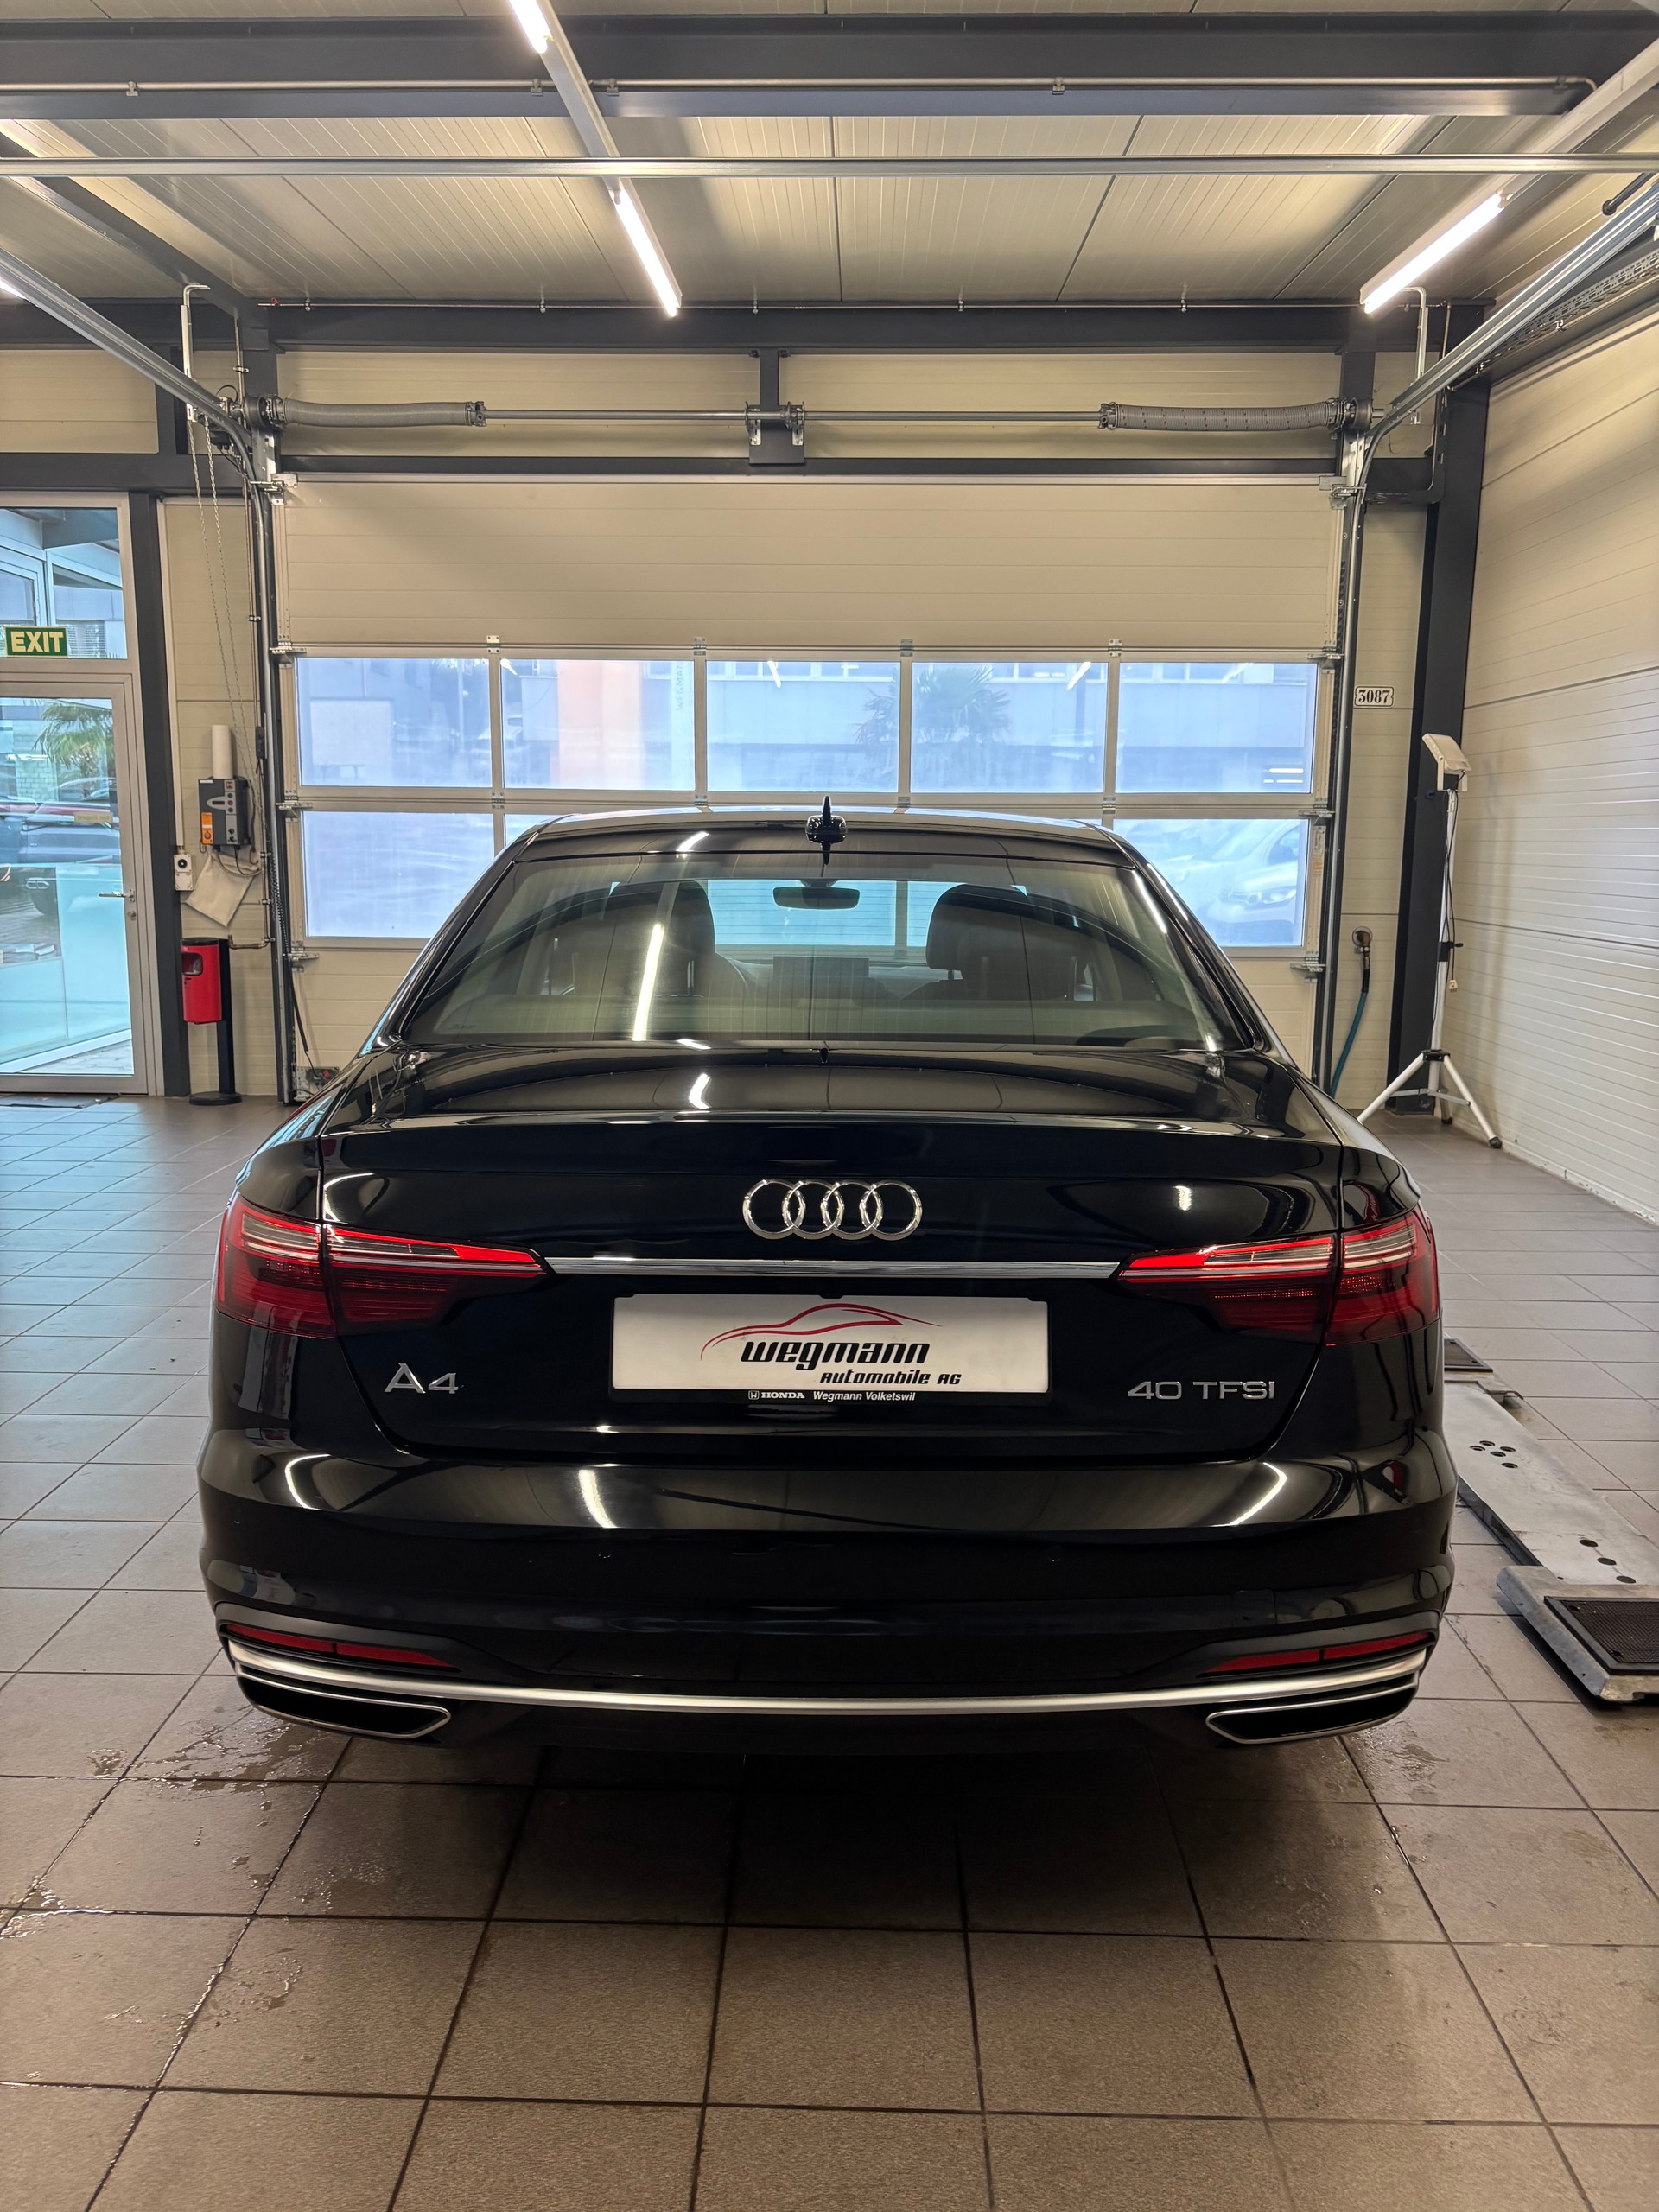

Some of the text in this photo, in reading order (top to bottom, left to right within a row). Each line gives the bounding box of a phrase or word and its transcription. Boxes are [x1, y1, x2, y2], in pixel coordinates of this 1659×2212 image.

[10, 631, 64, 652] EXIT
[1358, 689, 1390, 704] 3087
[741, 1341, 930, 1370] wegmann
[384, 1363, 459, 1395] A4
[937, 1373, 962, 1385] AG
[813, 1390, 862, 1402] Wegmann
[865, 1391, 916, 1401] Volketswil
[1128, 1381, 1275, 1400] 40 TFSI
